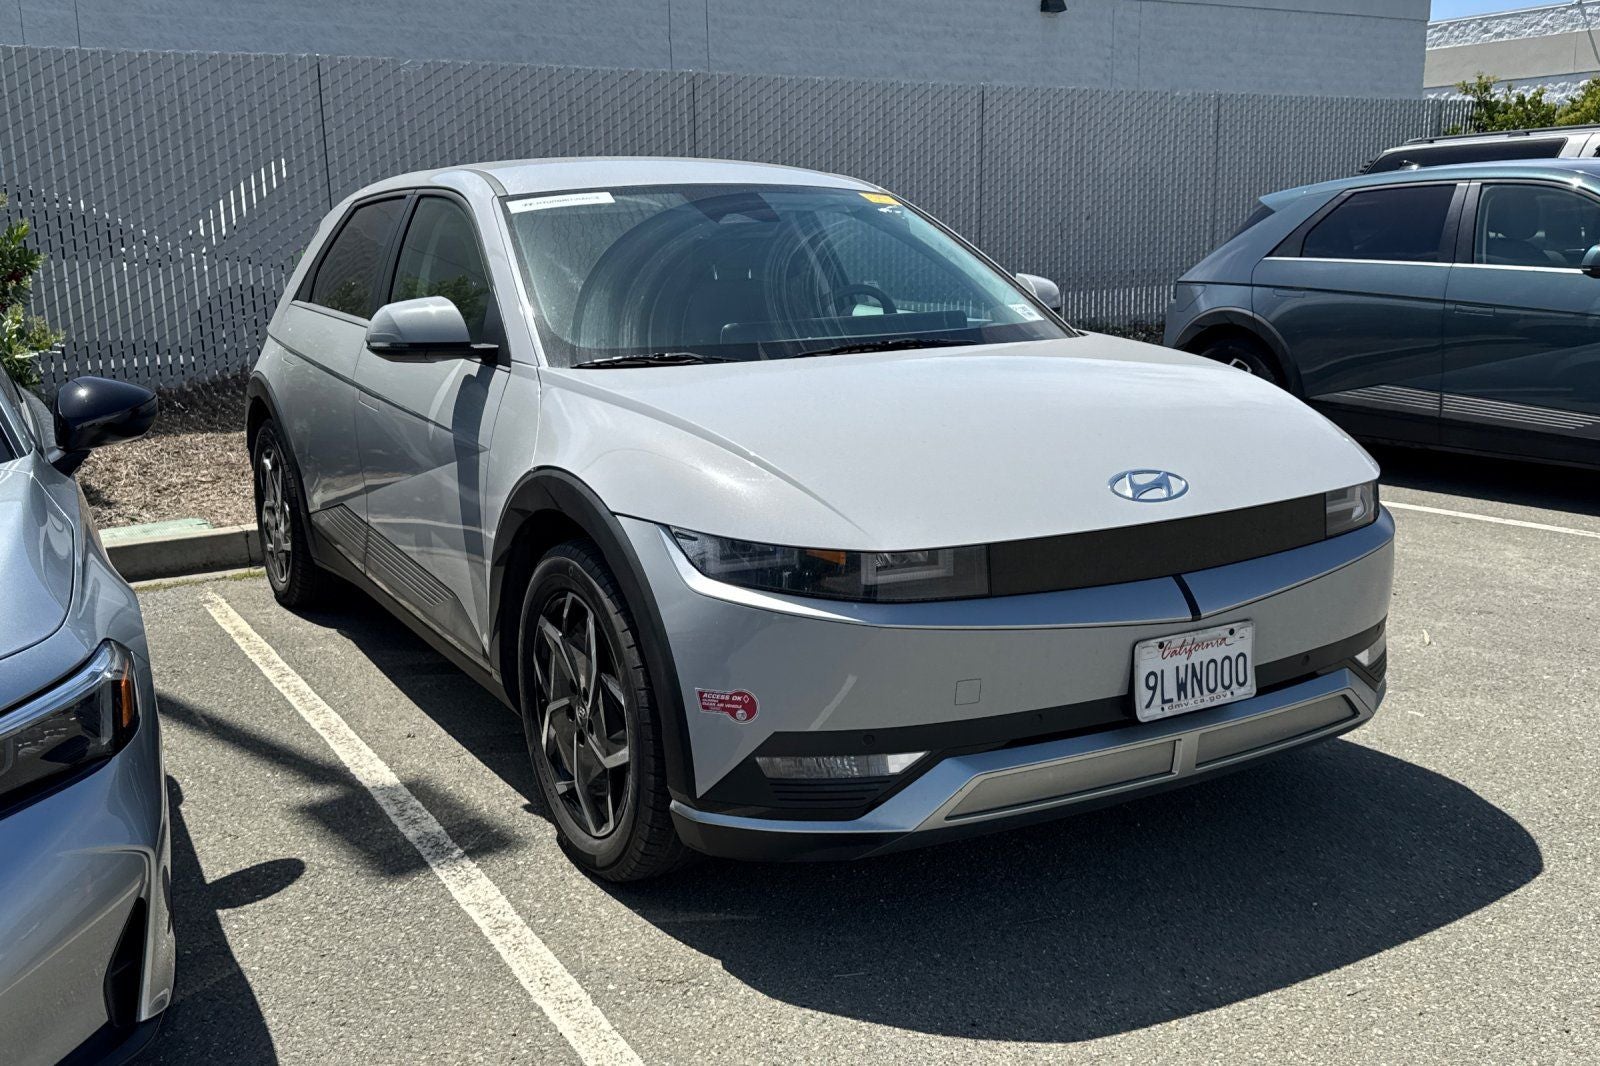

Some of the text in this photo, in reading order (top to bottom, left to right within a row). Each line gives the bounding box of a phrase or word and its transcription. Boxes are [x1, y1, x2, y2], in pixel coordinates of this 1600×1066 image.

[1161, 637, 1235, 660] California
[1145, 652, 1248, 709] 9LWN000
[1167, 692, 1228, 711] dmv.ca.gov
